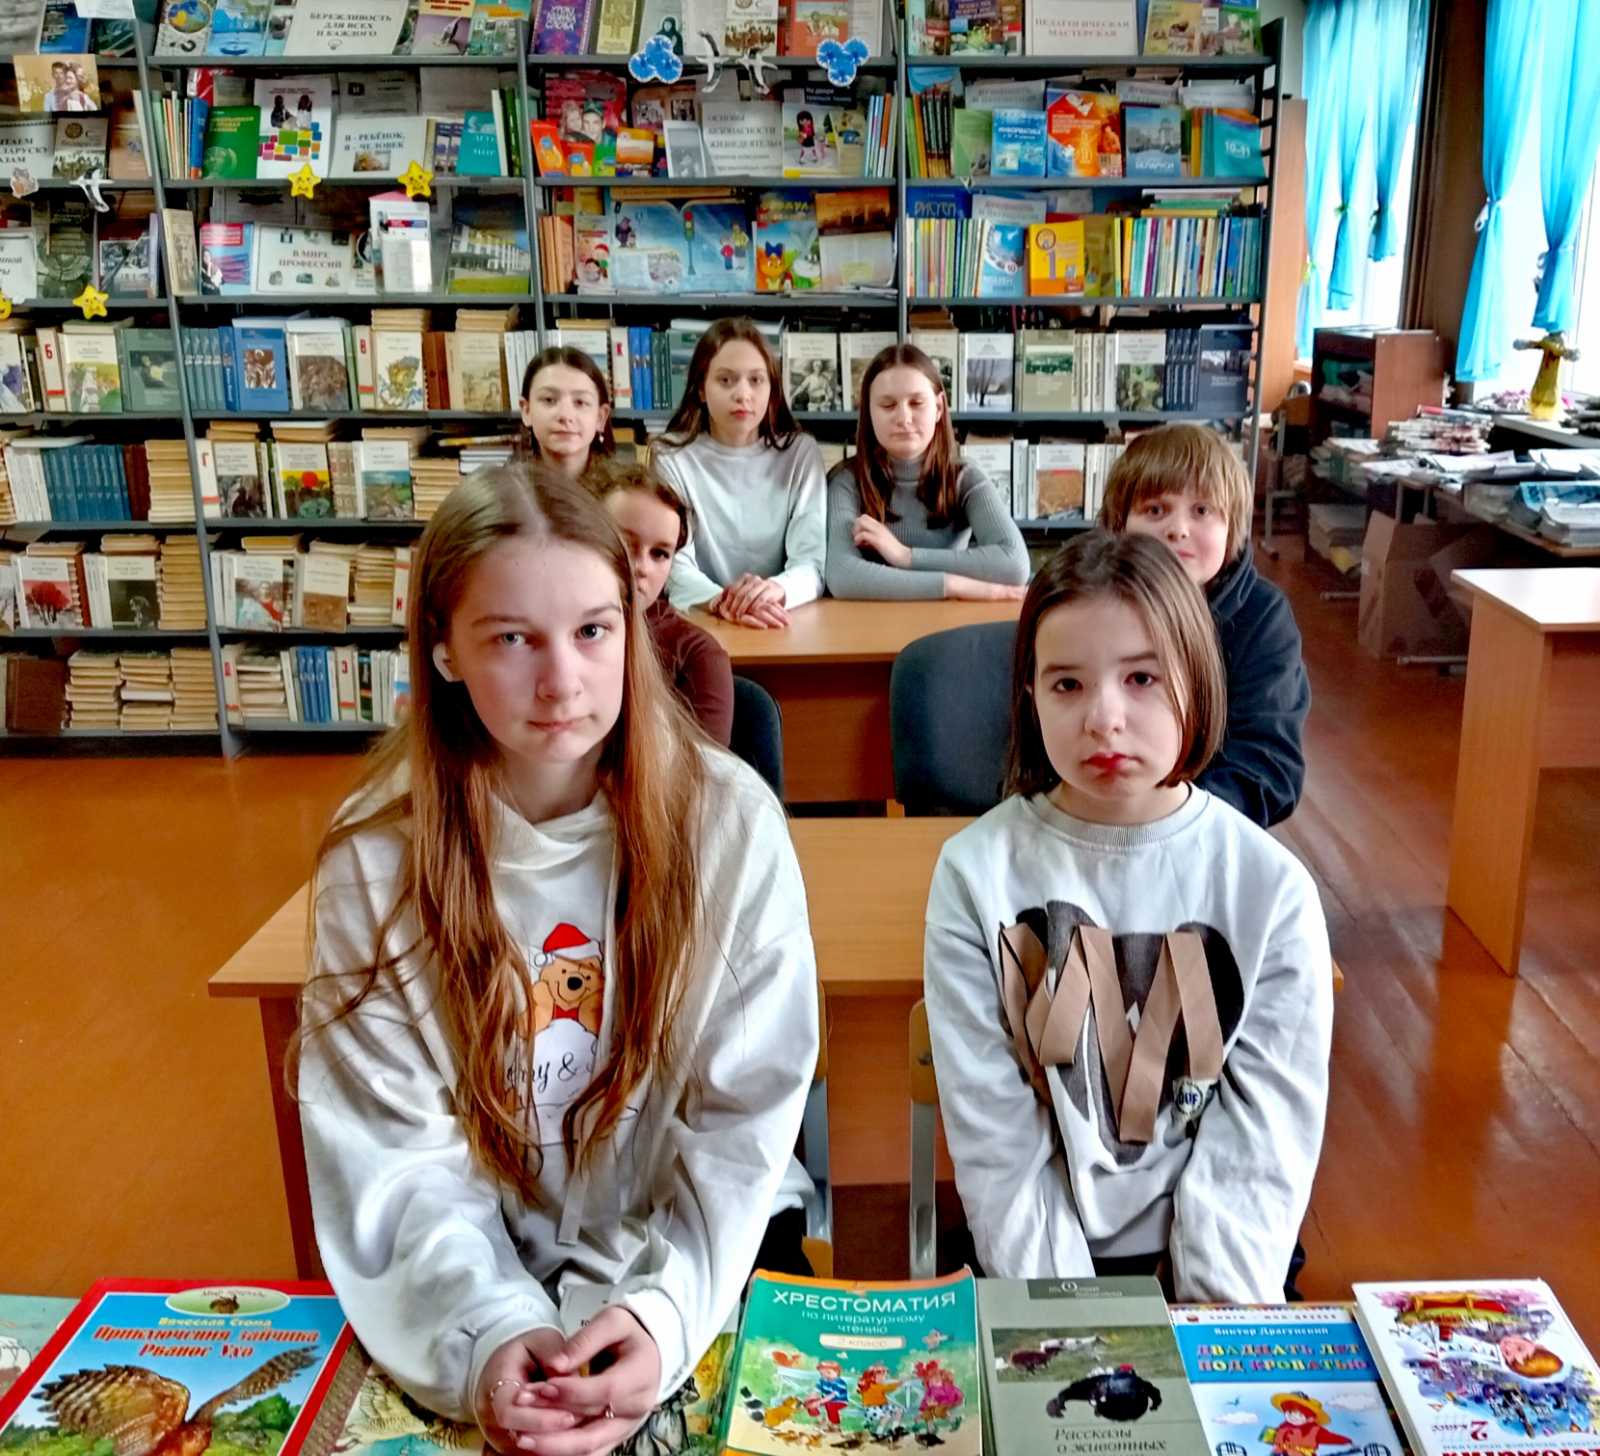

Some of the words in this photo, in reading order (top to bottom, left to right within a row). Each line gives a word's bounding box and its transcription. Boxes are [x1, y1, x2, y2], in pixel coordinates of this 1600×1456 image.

[310, 12, 392, 21] БЕРЕЖЛИВОСТЬ
[772, 1289, 957, 1313] ХРЕСТОМАТИЯ
[801, 1309, 819, 1319] по
[822, 1311, 926, 1325] литературному
[93, 1325, 231, 1342] Приключения
[837, 1324, 888, 1334] чтению
[1213, 1327, 1257, 1337] Виктор
[1260, 1327, 1329, 1337] Драгунский
[1197, 1344, 1313, 1358] ДВАДЦАТЬ
[1319, 1344, 1360, 1356] ЛЕТ
[1198, 1359, 1243, 1372] ПОД
[1251, 1359, 1368, 1371] КРОВАТЬЮ
[1055, 1428, 1132, 1441] Рассказы
[1470, 1420, 1488, 1441] 2
[1075, 1440, 1166, 1454] животных
